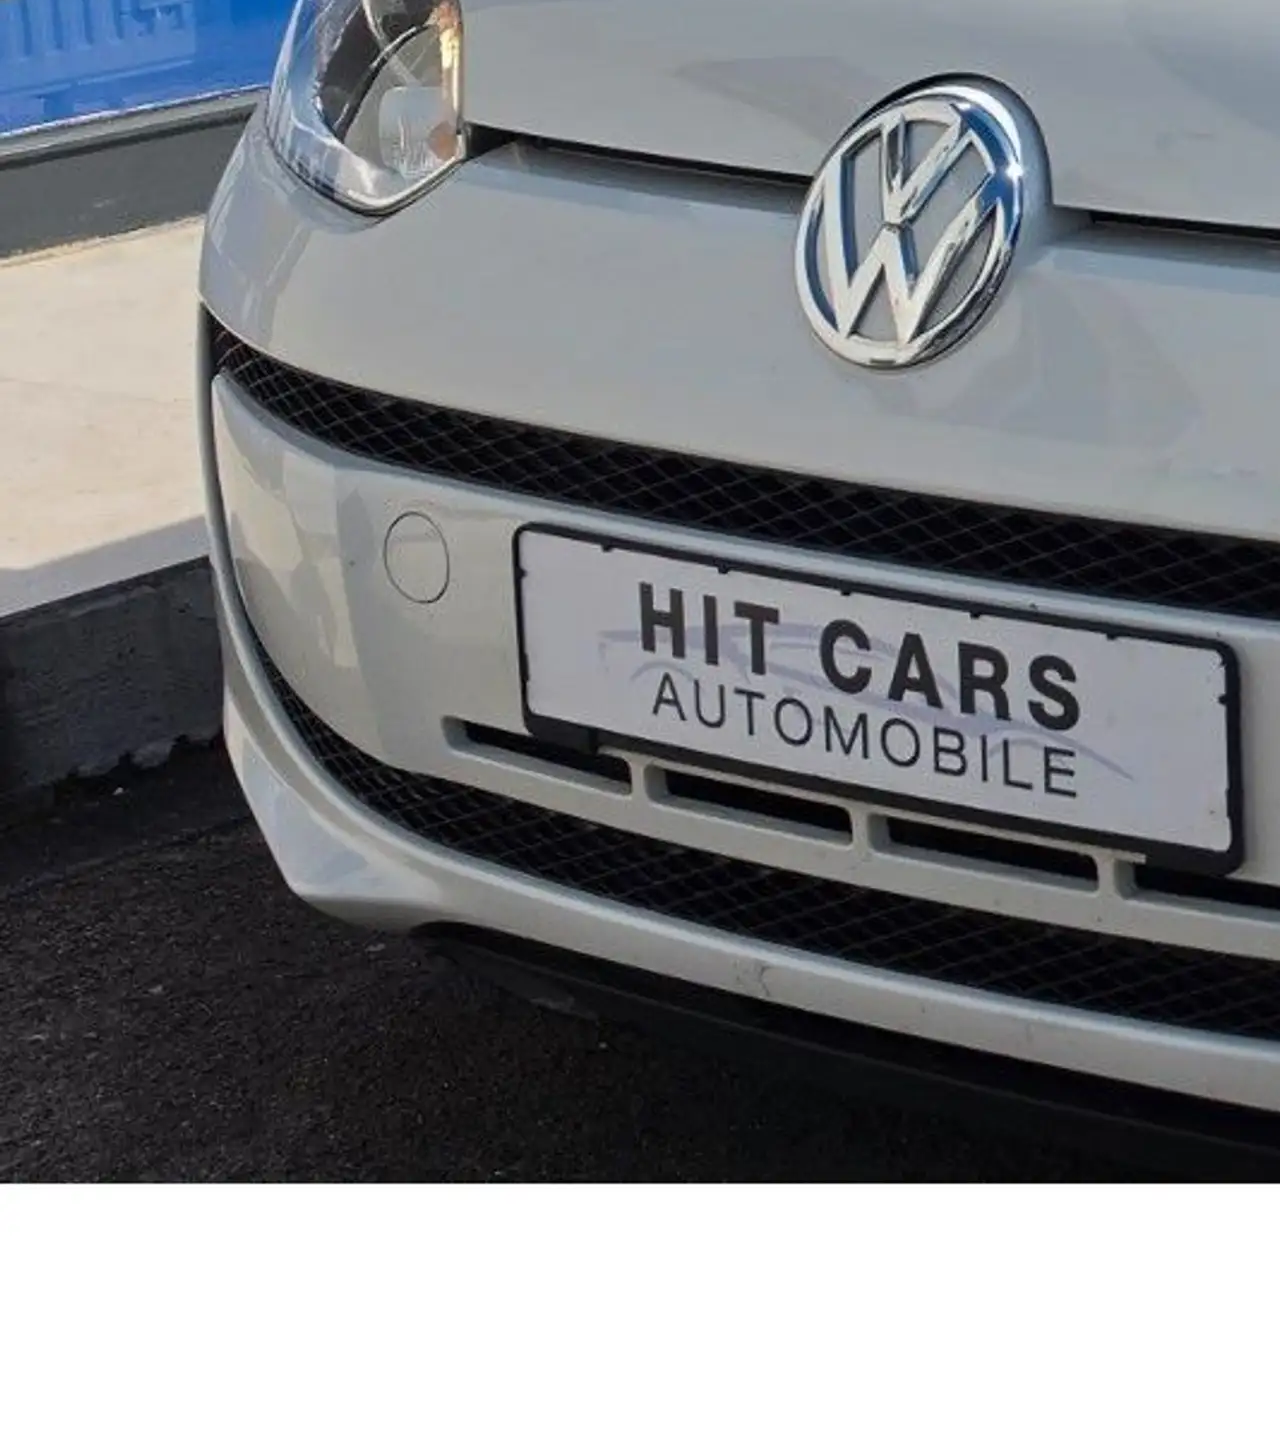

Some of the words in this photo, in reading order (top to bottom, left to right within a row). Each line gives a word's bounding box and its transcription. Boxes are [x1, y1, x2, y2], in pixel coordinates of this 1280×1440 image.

[639, 581, 780, 675] HIT
[819, 618, 1080, 731] CARS
[652, 672, 1078, 798] AUTOMOBILE
